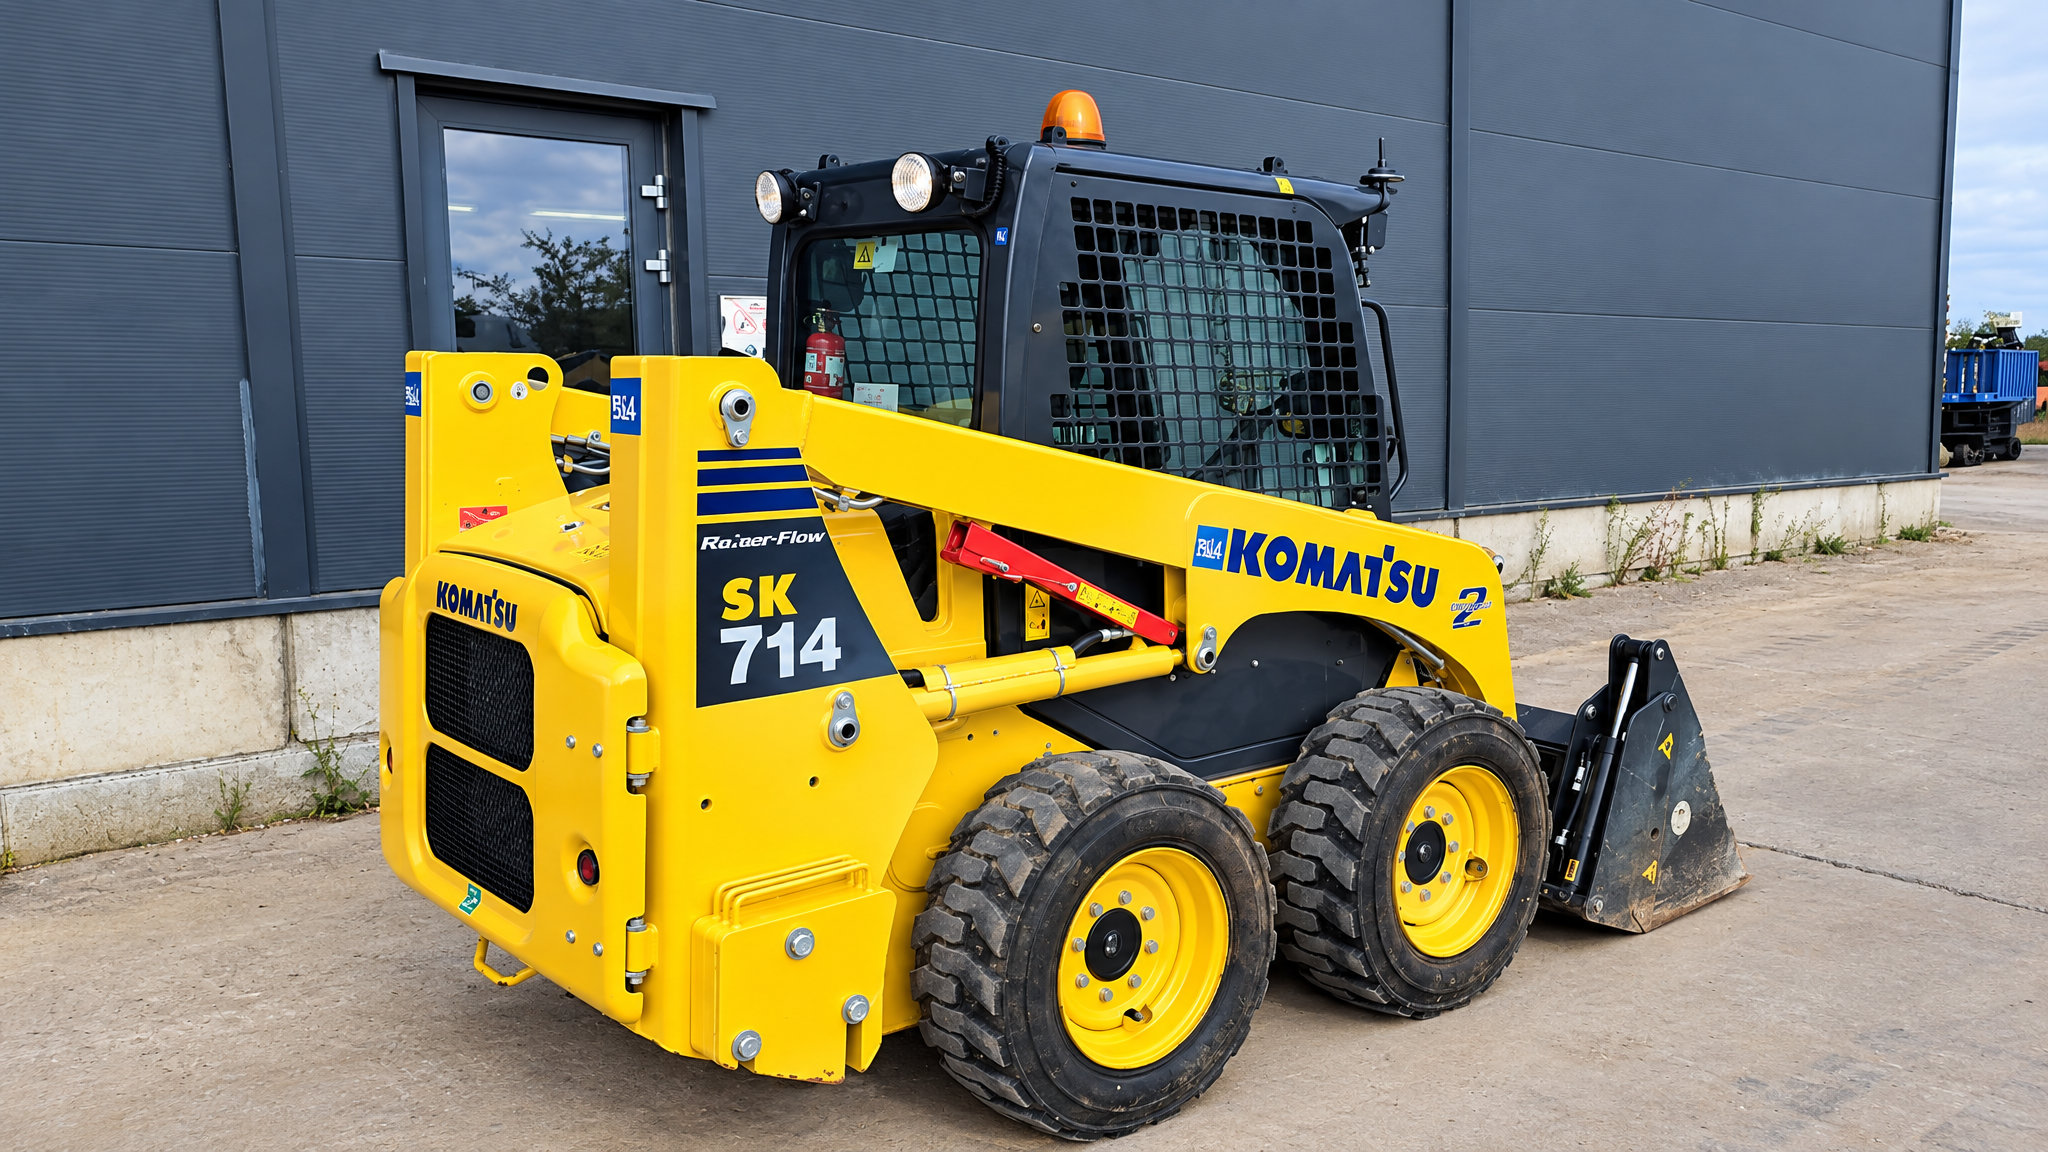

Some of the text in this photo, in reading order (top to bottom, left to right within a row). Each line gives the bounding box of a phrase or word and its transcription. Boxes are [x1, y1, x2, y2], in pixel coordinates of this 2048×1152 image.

[721, 573, 798, 621] SK
[1226, 527, 1440, 608] KOMATSU
[436, 580, 518, 633] KOMATSU
[720, 616, 842, 685] 714
